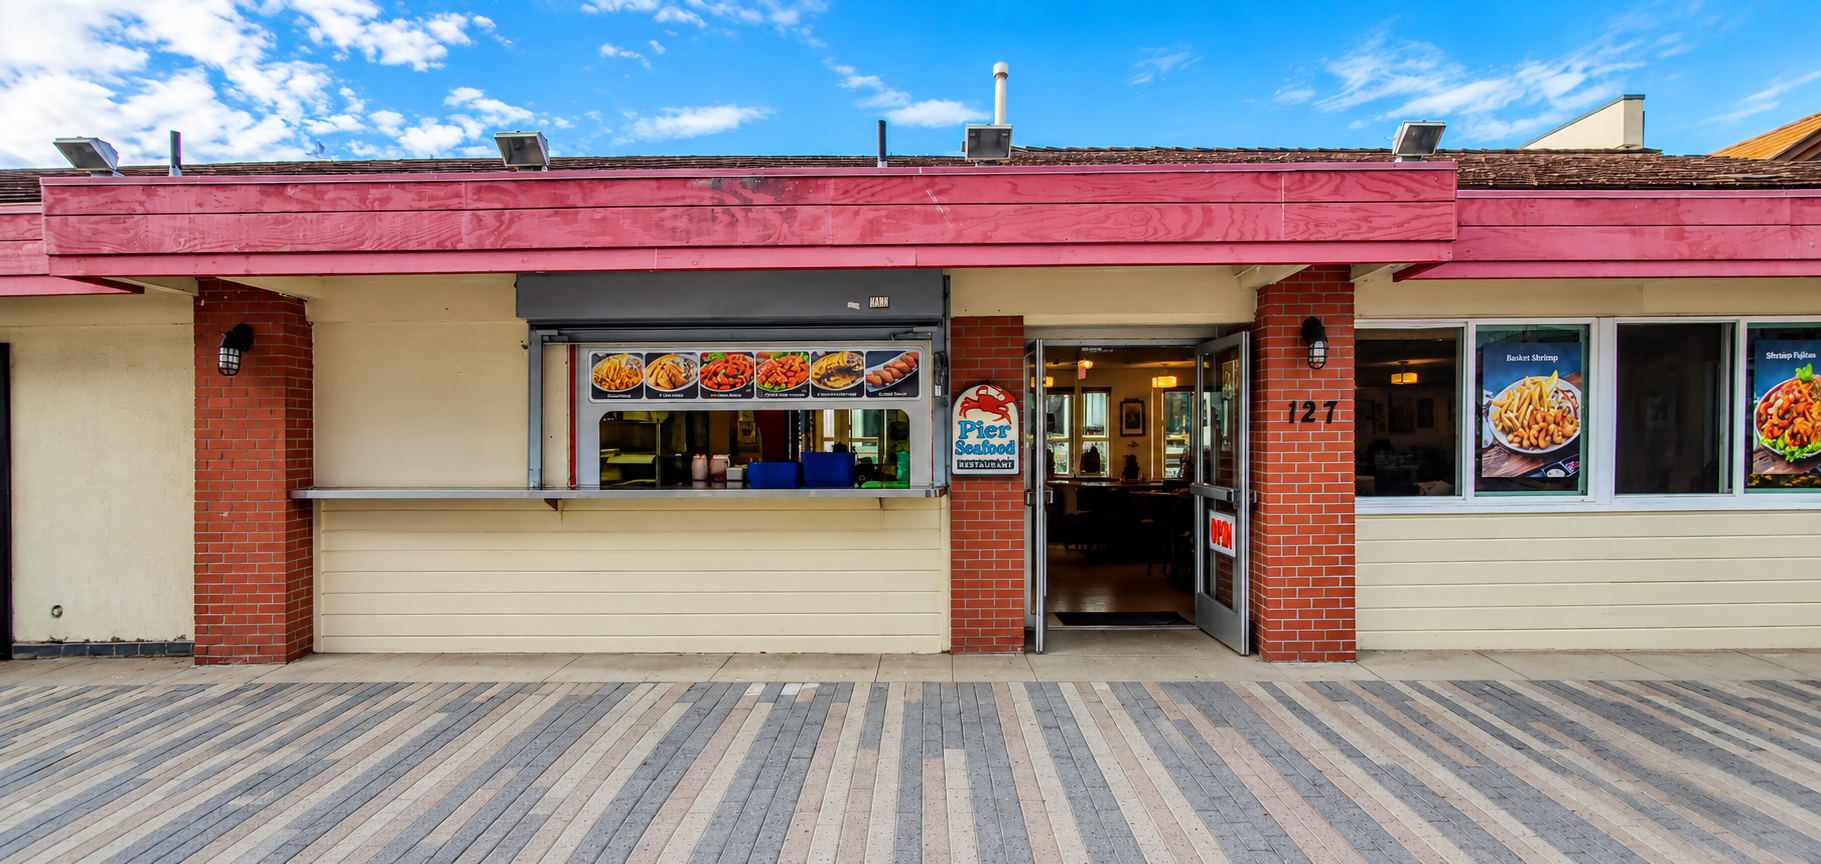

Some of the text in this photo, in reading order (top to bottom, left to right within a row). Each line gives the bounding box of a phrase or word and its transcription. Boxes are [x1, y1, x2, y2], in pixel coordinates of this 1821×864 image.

[1531, 353, 1559, 364] Shrimp
[1765, 351, 1793, 361] Shrimp
[1288, 400, 1338, 424] 127
[957, 420, 1012, 439] Pier
[954, 439, 1016, 456] Seafood
